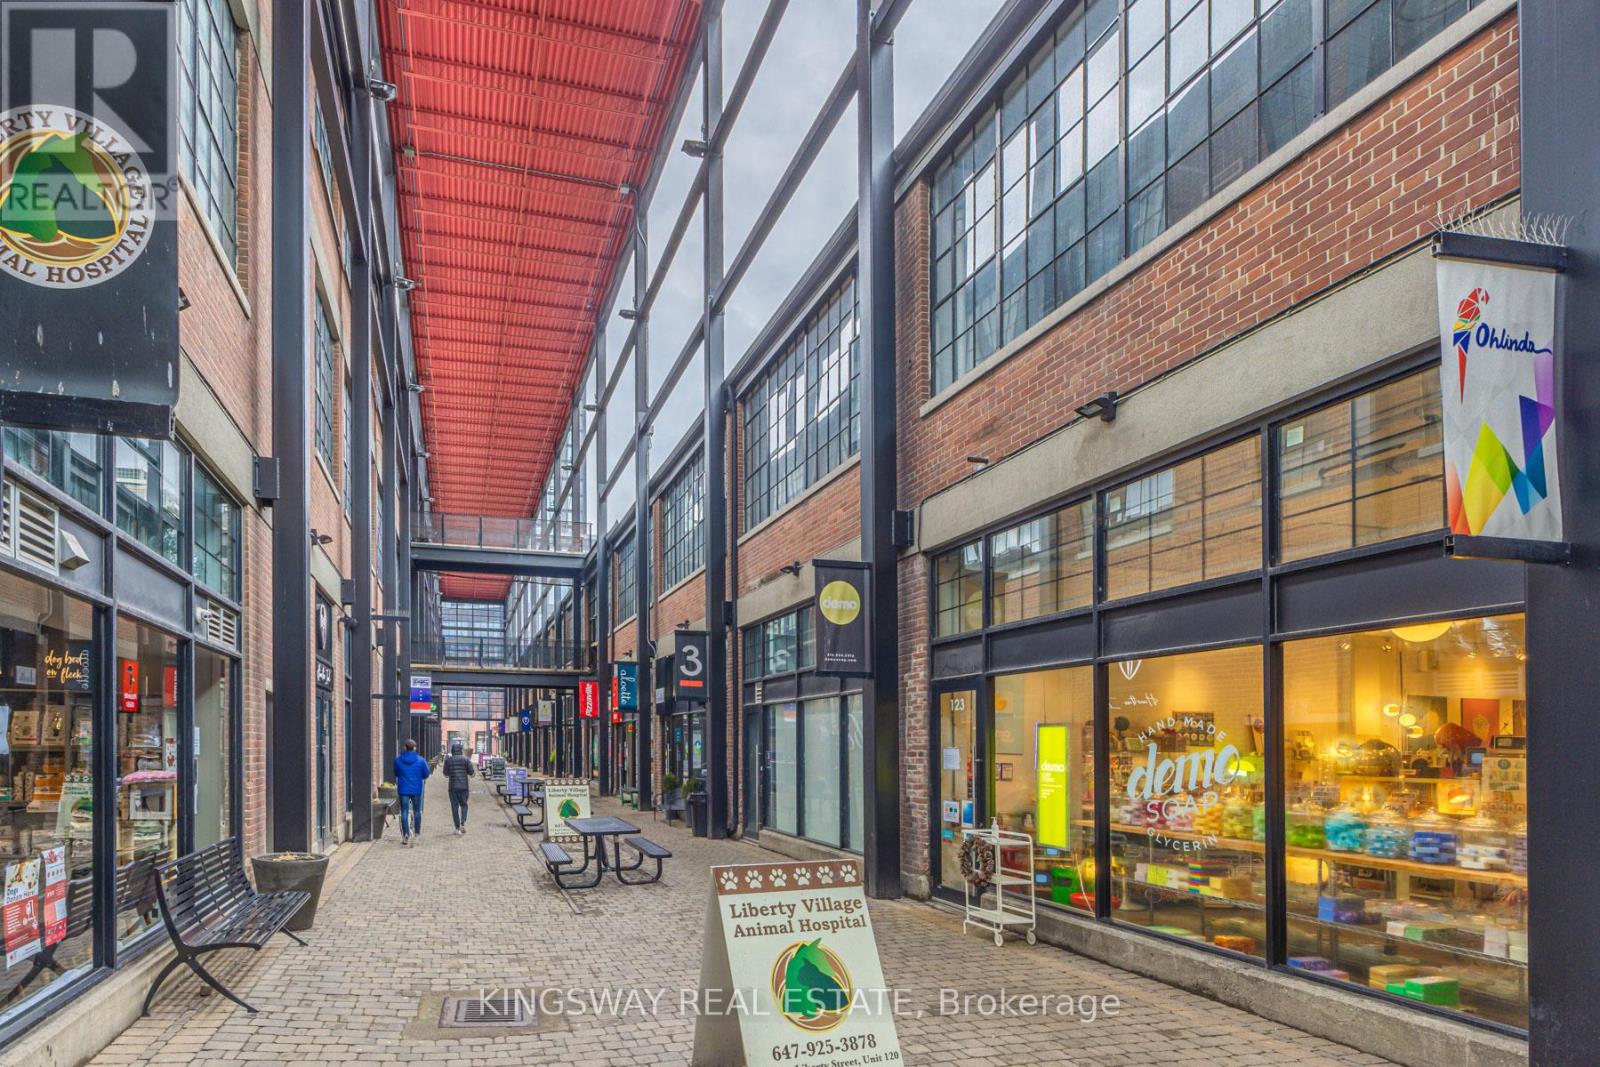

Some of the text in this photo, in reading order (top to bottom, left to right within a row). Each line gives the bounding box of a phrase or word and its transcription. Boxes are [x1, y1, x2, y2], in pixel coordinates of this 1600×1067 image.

[0, 111, 146, 201] RTY VILLAGE
[46, 214, 149, 283] HOSPITAL
[1476, 322, 1552, 354] Ohlinda
[823, 596, 857, 610] demo
[44, 649, 63, 669] dog
[680, 644, 703, 676] 3
[585, 683, 593, 717] Pizzaville
[620, 669, 636, 705] aloette
[951, 698, 965, 711] 123
[1138, 716, 1227, 743] HAND MADE
[1127, 742, 1240, 801] demo
[1146, 791, 1219, 823] SOAP
[1146, 827, 1220, 852] GLYCERIN
[729, 897, 863, 919] Liberty Village
[733, 915, 867, 938] Animal Hospital
[772, 1033, 877, 1062] 647-925-3878
[863, 1054, 882, 1064] Unit
[885, 1051, 899, 1061] 120
